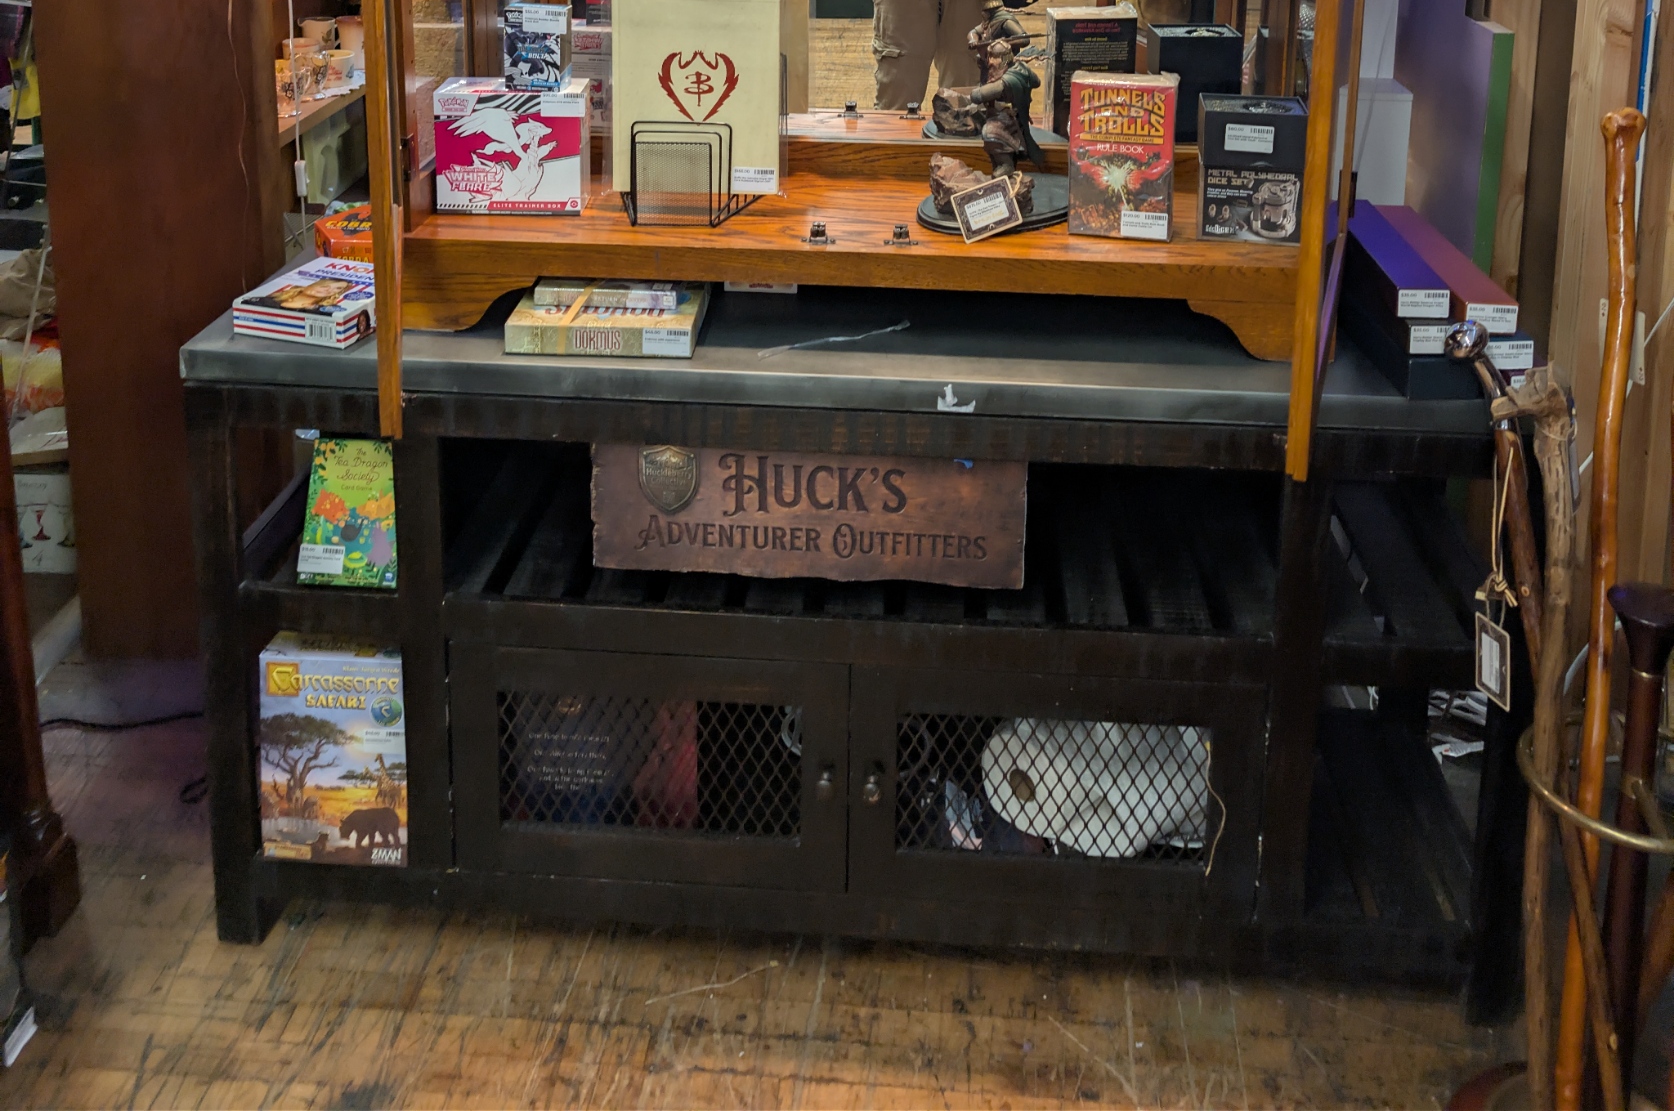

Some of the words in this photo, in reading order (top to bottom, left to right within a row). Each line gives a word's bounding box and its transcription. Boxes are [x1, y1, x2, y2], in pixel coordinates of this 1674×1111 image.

[1080, 88, 1165, 117] TUNNELS
[1100, 105, 1145, 117] AND
[1080, 109, 1165, 136] TROLLS
[1096, 144, 1118, 152] RULE
[1120, 144, 1144, 154] BOOK
[450, 172, 496, 182] WHITE
[1207, 177, 1228, 185] DICE
[1231, 178, 1249, 186] SET
[1208, 168, 1237, 178] METAL
[1241, 170, 1298, 181] POLYHEDRAL
[325, 220, 373, 228] COBR
[315, 269, 374, 280] PRESIDEN
[574, 328, 621, 351] DOKMUS
[334, 455, 349, 467] Tea
[352, 456, 388, 469] Dragon
[336, 469, 379, 485] Society
[719, 452, 907, 517] HUCK'S
[635, 515, 821, 553] ADVENTURER
[833, 522, 988, 560] OUTFITTERS
[272, 667, 400, 694] Carcassonne
[305, 694, 367, 710] SAFARI
